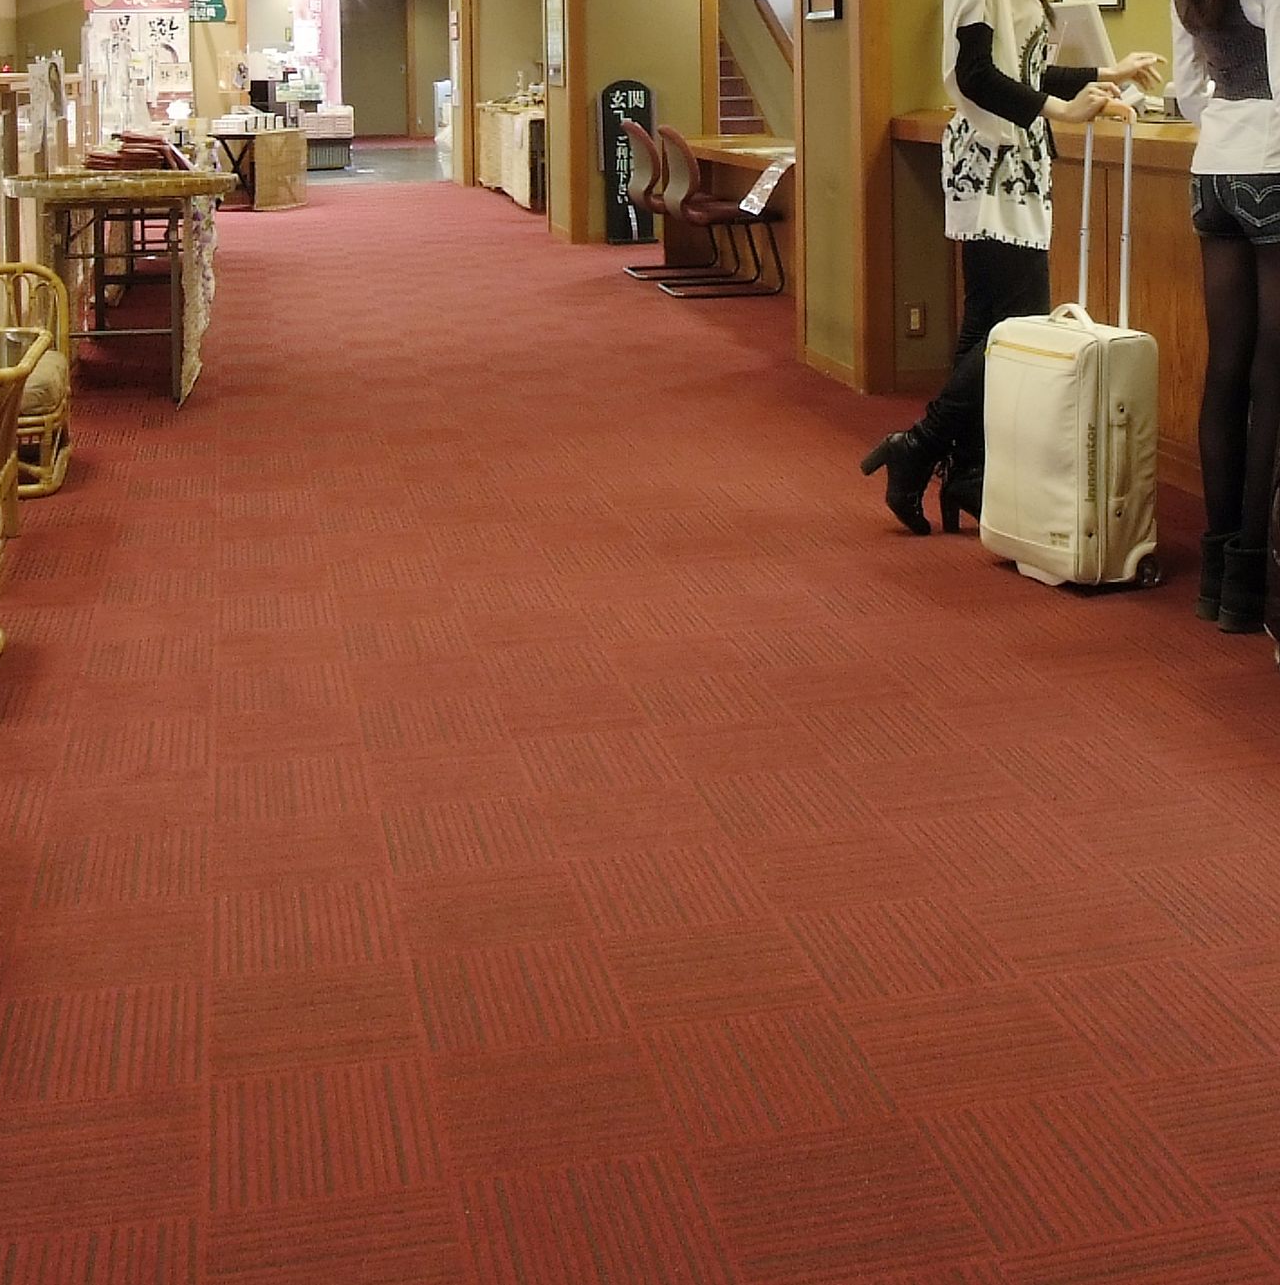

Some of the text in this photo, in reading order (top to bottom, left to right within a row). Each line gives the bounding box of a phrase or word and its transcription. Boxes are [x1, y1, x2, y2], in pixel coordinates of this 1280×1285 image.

[610, 90, 646, 109] 玄関
[615, 135, 629, 204] ご利用下さい
